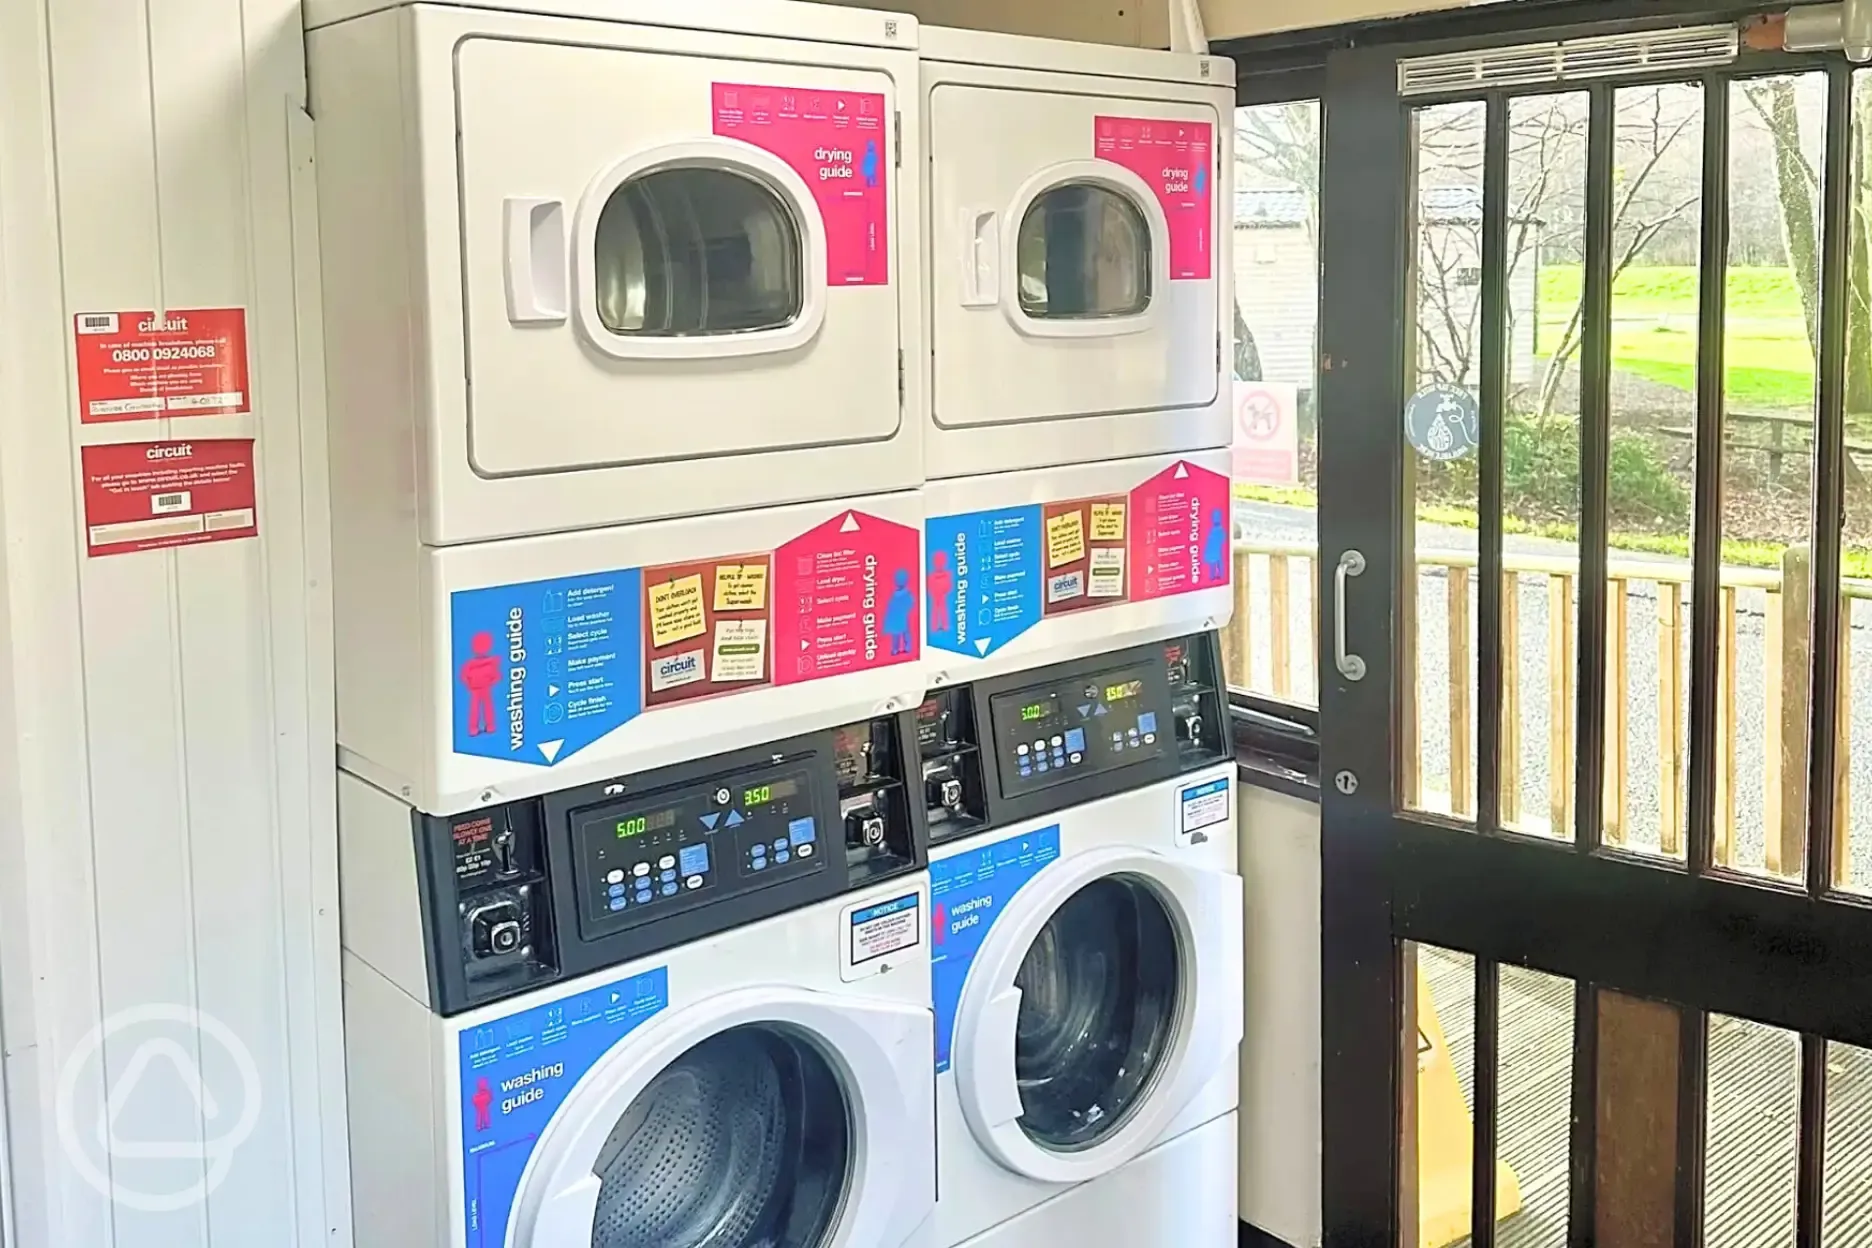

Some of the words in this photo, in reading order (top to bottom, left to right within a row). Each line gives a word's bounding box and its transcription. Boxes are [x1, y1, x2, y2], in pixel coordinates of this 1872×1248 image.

[814, 147, 853, 163] drying
[819, 165, 853, 180] guide
[1162, 168, 1189, 180] drying
[1165, 181, 1189, 194] guide
[112, 349, 150, 362] 0800
[152, 346, 216, 361] 0924068
[146, 443, 192, 460] circuit
[1189, 497, 1201, 542] drying
[955, 532, 968, 577] guide
[1189, 544, 1201, 584] guide
[863, 554, 878, 609] drying
[1054, 577, 1078, 590] circuit
[567, 589, 582, 597] Add
[582, 584, 615, 595] detergent
[567, 614, 585, 623] Load
[585, 611, 610, 621] washer
[955, 578, 968, 645] washing
[506, 606, 526, 664] guide
[567, 631, 589, 640] Select
[589, 628, 608, 638] cycle
[863, 612, 878, 660] guide
[567, 658, 587, 667] Make
[587, 652, 616, 664] payment
[660, 656, 697, 675] circuit
[567, 680, 587, 689] Press
[588, 676, 604, 685] start
[506, 667, 526, 751] washing
[567, 699, 587, 709] Cycle
[588, 696, 607, 704] finish
[873, 902, 899, 916] NOTICE
[951, 893, 993, 917] washing
[951, 913, 980, 934] guide
[500, 1060, 564, 1093] washing
[501, 1088, 544, 1114] guide
